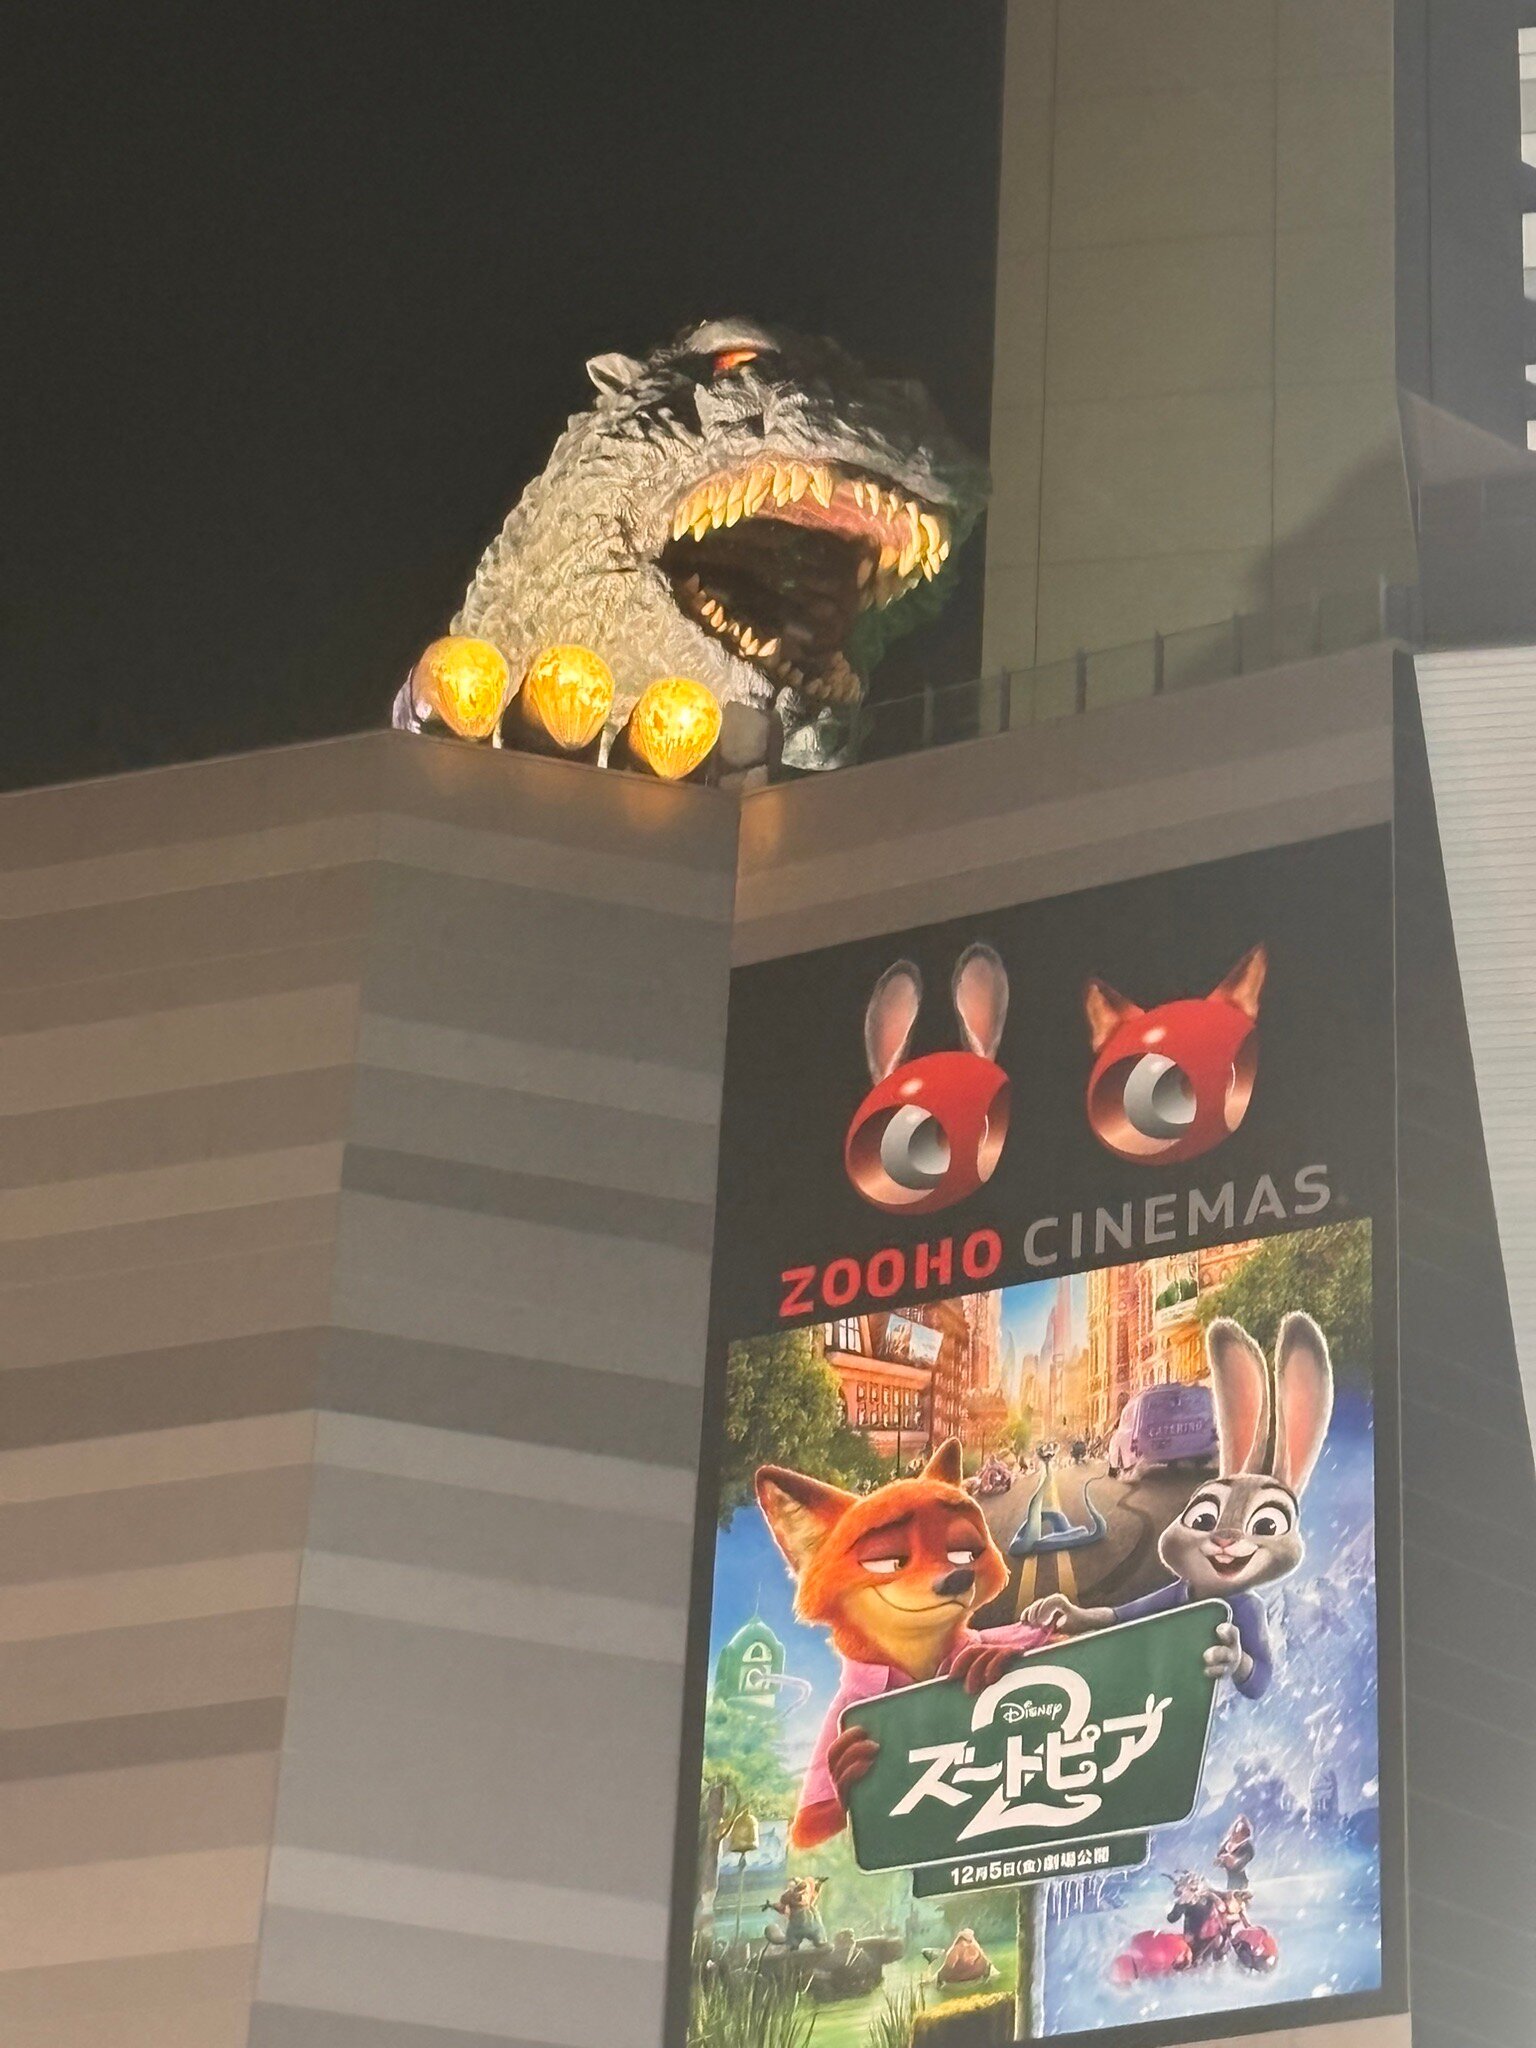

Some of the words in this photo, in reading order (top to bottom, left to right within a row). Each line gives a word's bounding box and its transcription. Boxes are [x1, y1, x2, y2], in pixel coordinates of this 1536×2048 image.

[779, 1229, 1003, 1318] ZOOHO
[1023, 1165, 1331, 1267] CINEMAS
[889, 1693, 1174, 1817] ズートピア
[951, 1845, 1110, 1886] 12月5日(金)劇場公開
